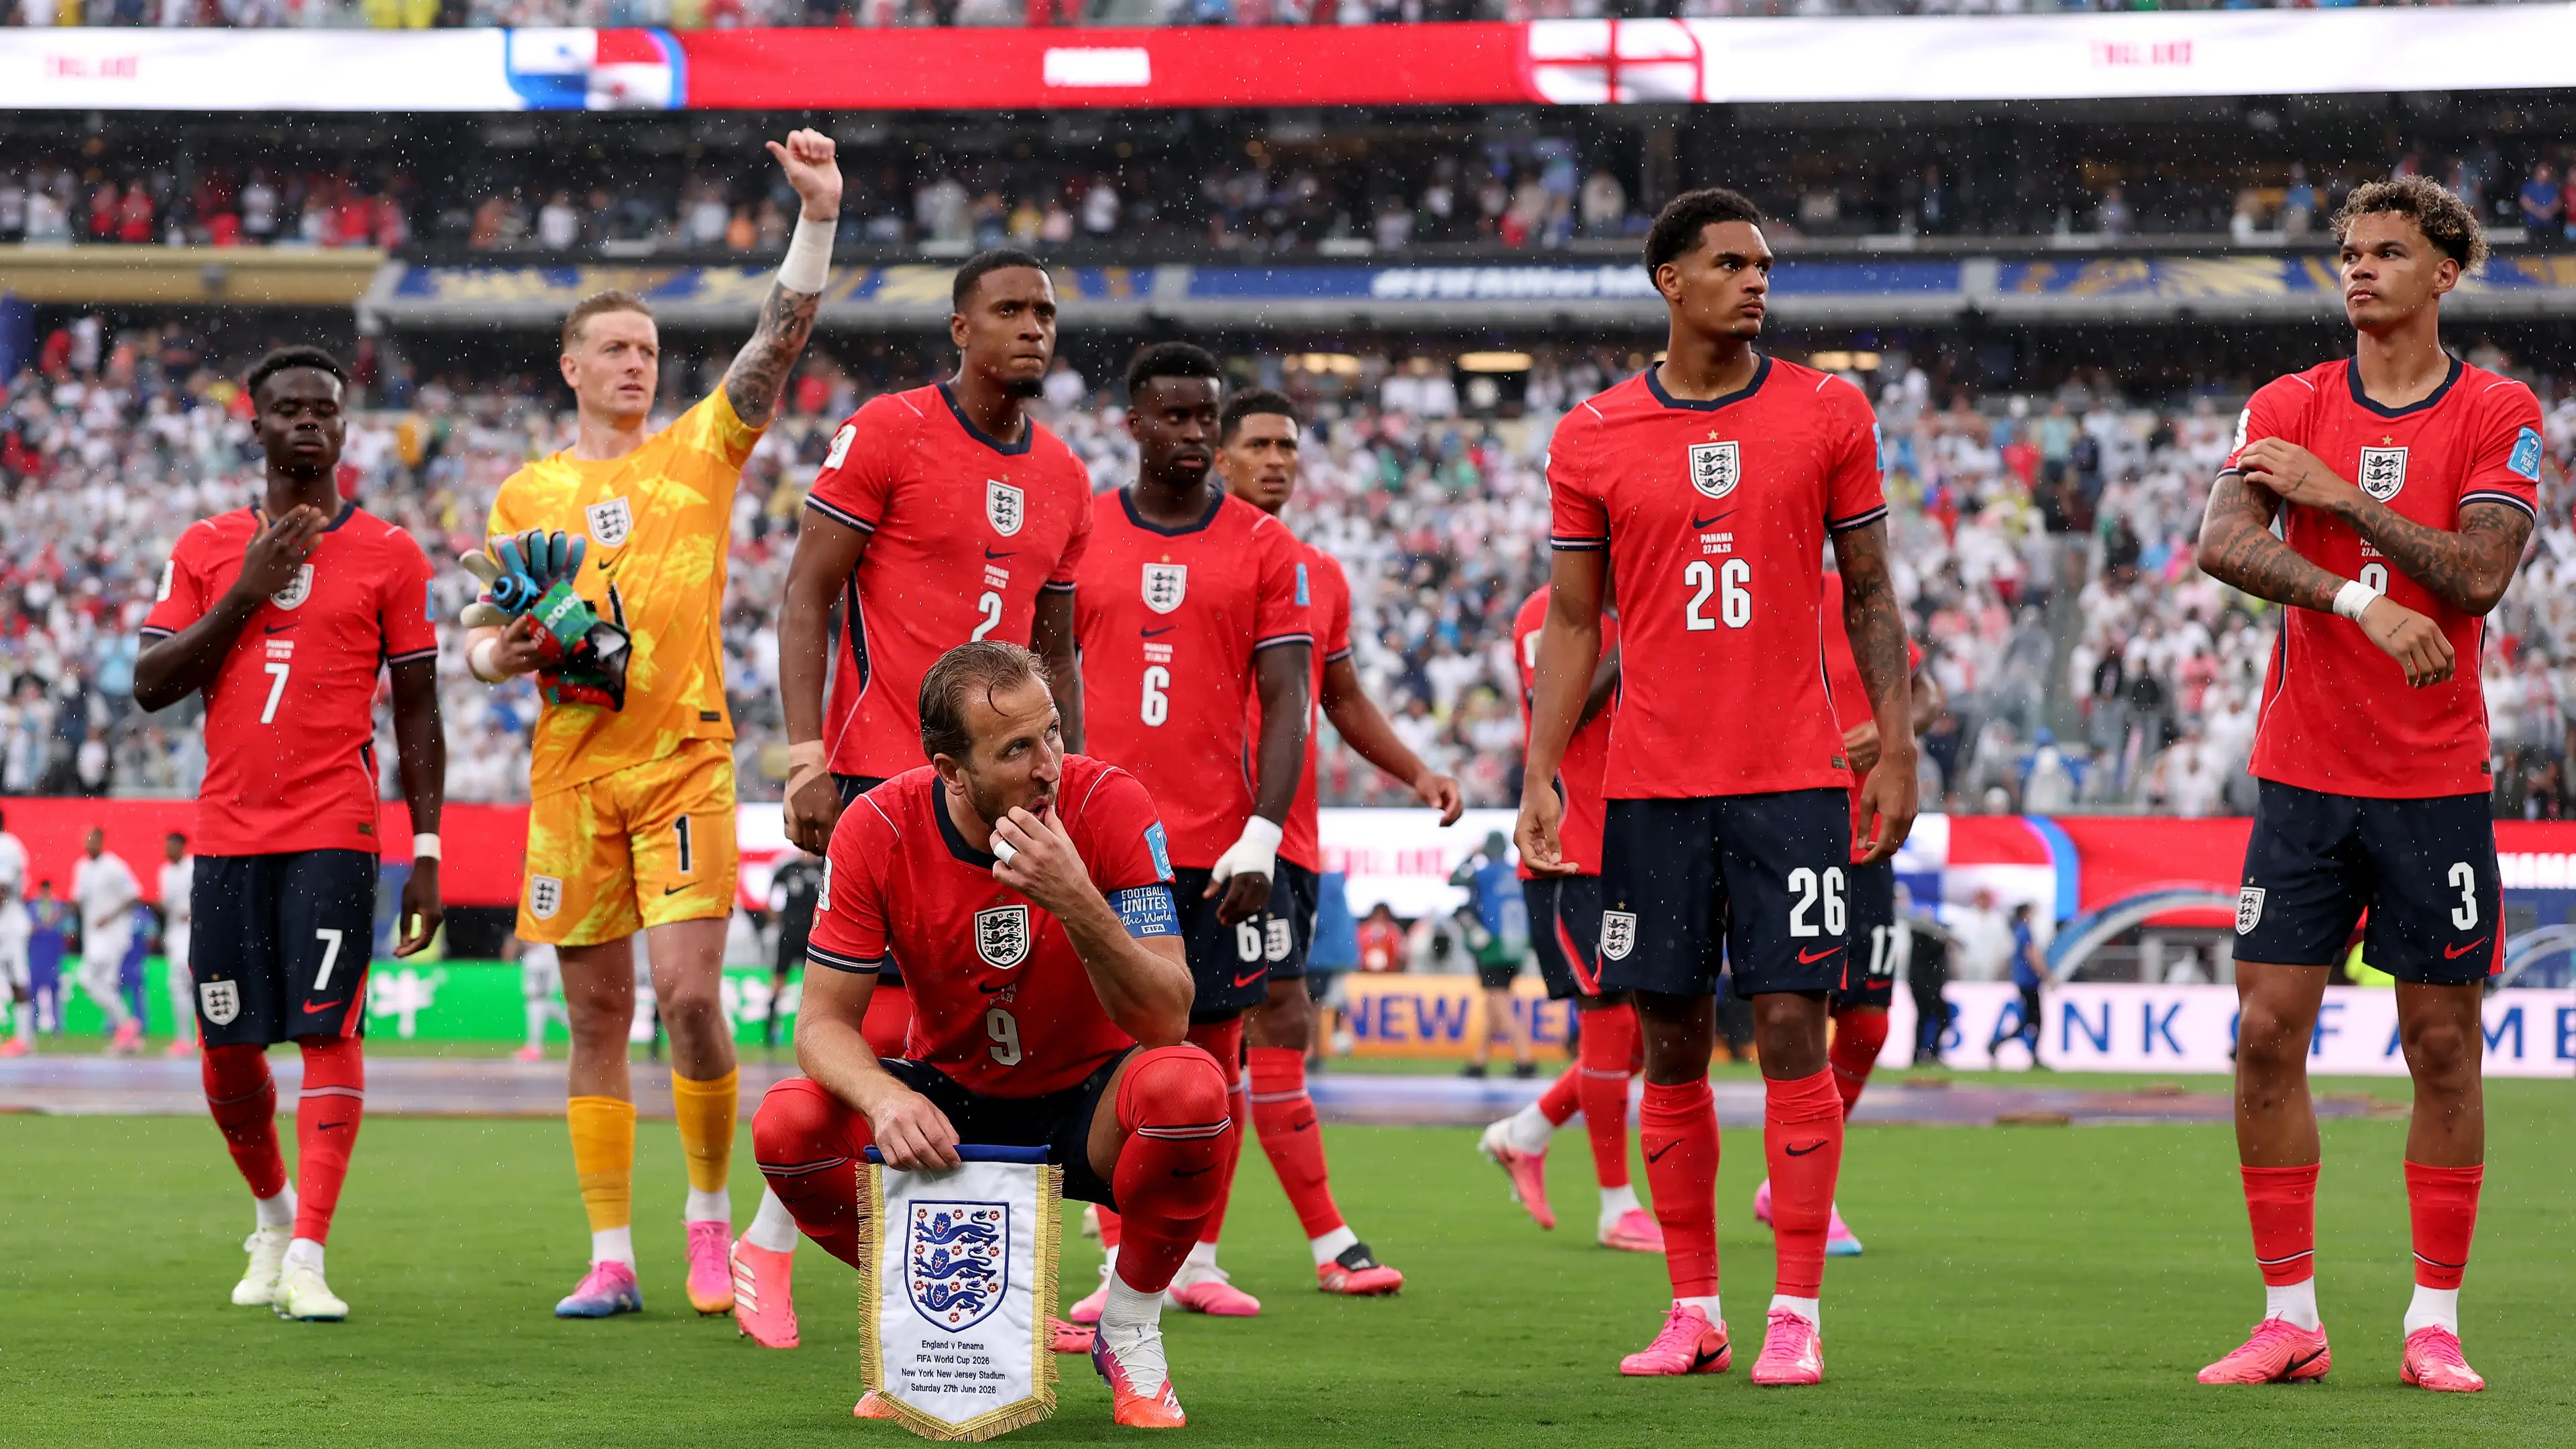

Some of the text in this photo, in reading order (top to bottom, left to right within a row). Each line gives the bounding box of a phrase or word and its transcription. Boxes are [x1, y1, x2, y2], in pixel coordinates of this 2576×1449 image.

[1700, 532, 1734, 544] PANAMA
[970, 590, 1004, 643] 2
[1684, 557, 1752, 632] 26
[259, 661, 290, 724] 7
[1140, 665, 1171, 727] 6
[673, 814, 692, 874] 1
[1120, 910, 1173, 926] the World
[1121, 886, 1165, 900] FOOTBALL
[1122, 896, 1168, 913] UNITES
[1787, 866, 1847, 937] 26
[2447, 861, 2479, 931] 3
[313, 928, 343, 991] 7
[1236, 914, 1263, 963] 6
[985, 1007, 1022, 1067] 9
[916, 1354, 989, 1365] FIFA World Cup 2026
[922, 1340, 949, 1350] England
[957, 1342, 984, 1350] Panama
[902, 1368, 1006, 1380] New York New Jersey Stadium
[911, 1383, 996, 1394] Saturday 27th June 2026
